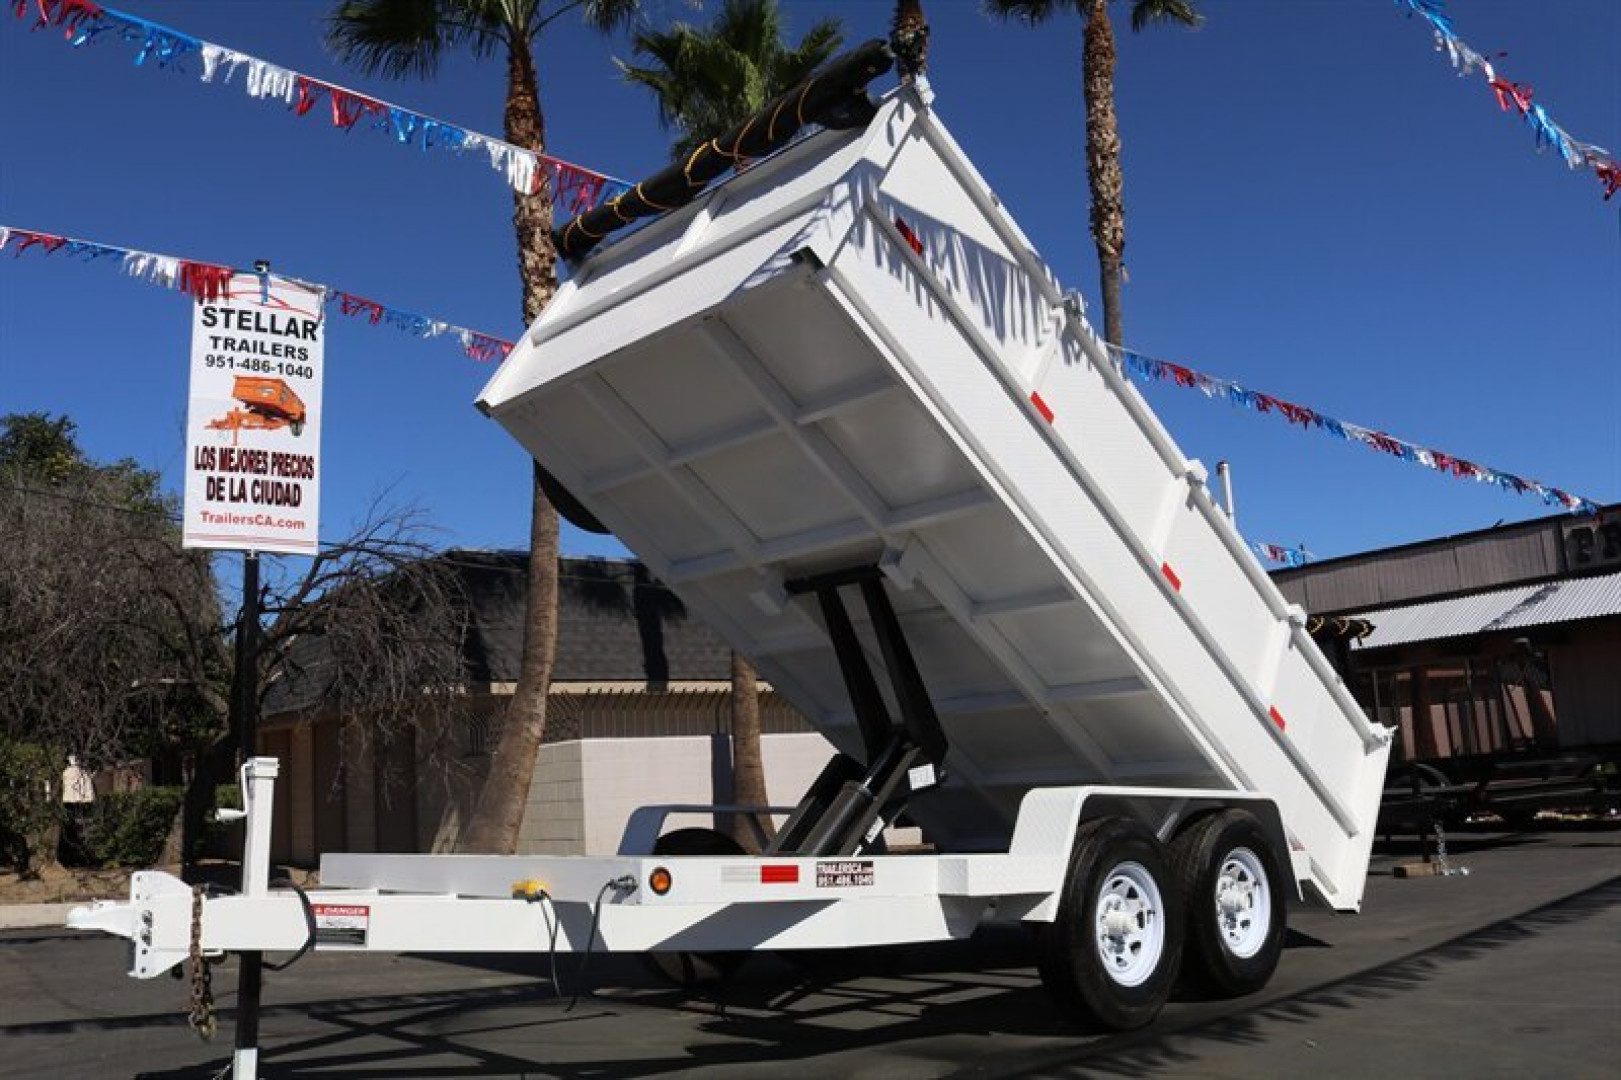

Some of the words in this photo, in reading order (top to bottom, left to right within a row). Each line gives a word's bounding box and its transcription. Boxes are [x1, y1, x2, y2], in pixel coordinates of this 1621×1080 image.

[201, 305, 318, 341] STELLAR
[209, 335, 309, 361] TRAILERS
[205, 354, 313, 379] 951-486-1040
[194, 446, 216, 471] LOS
[218, 447, 268, 474] MEJORES
[271, 451, 314, 480] PRECIOS
[206, 476, 226, 501] DE
[229, 478, 247, 503] LA
[250, 478, 303, 507] CIUDAD
[200, 511, 305, 529] TrailersCA.com
